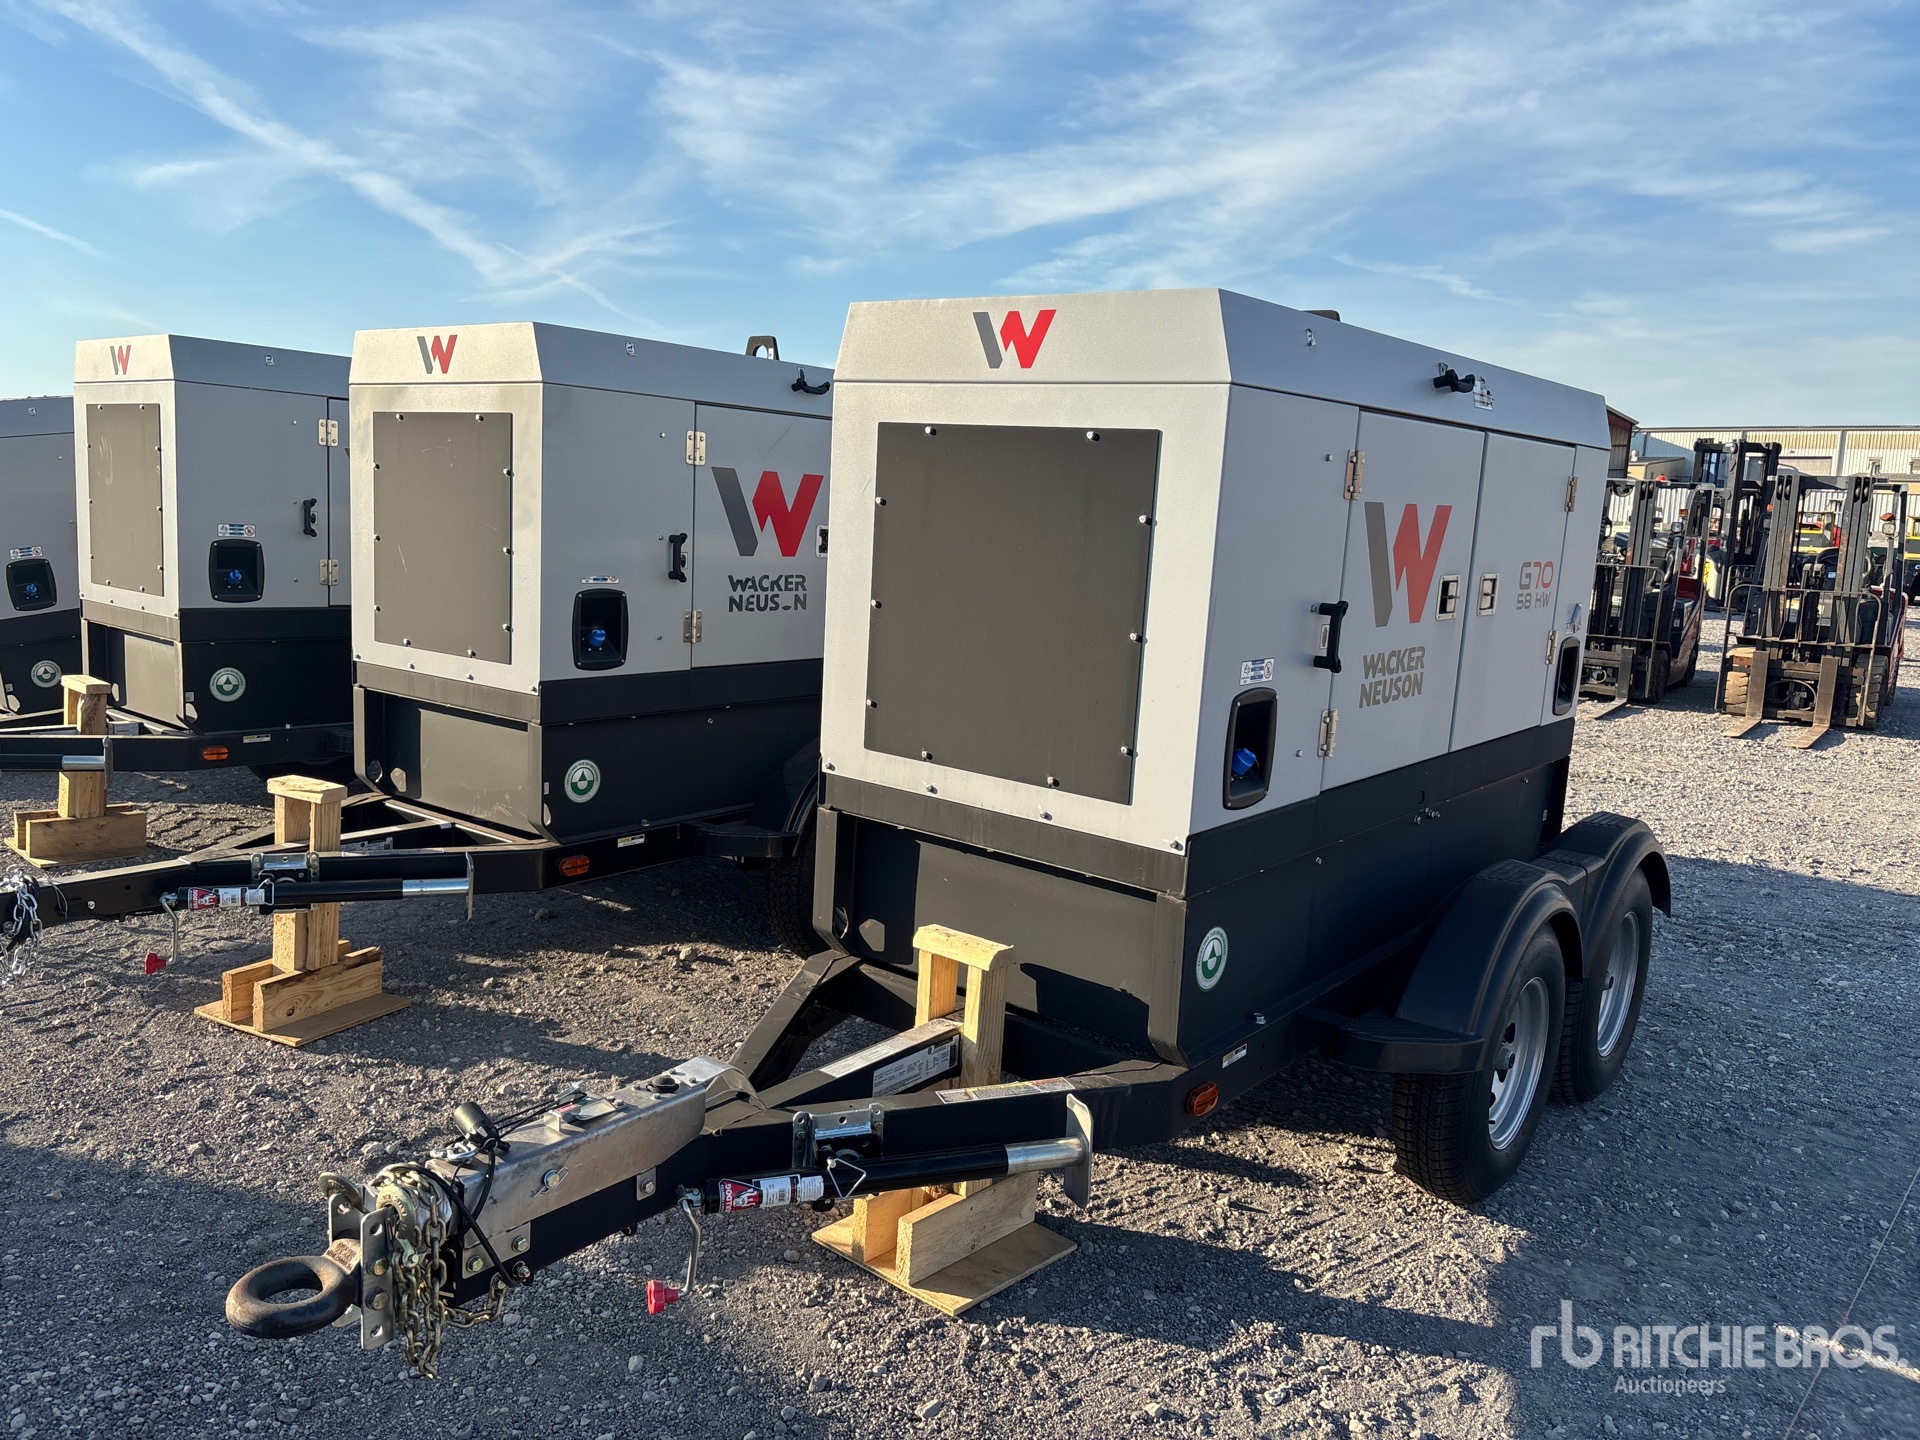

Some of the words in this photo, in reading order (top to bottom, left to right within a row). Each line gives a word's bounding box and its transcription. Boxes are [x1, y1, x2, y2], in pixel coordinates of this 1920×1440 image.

[727, 574, 808, 592] WACKER
[1519, 560, 1554, 590] G70
[728, 593, 808, 612] NEUSN
[1516, 592, 1532, 610] 58
[1362, 645, 1426, 680] WACKER
[1358, 671, 1424, 709] NEUSON
